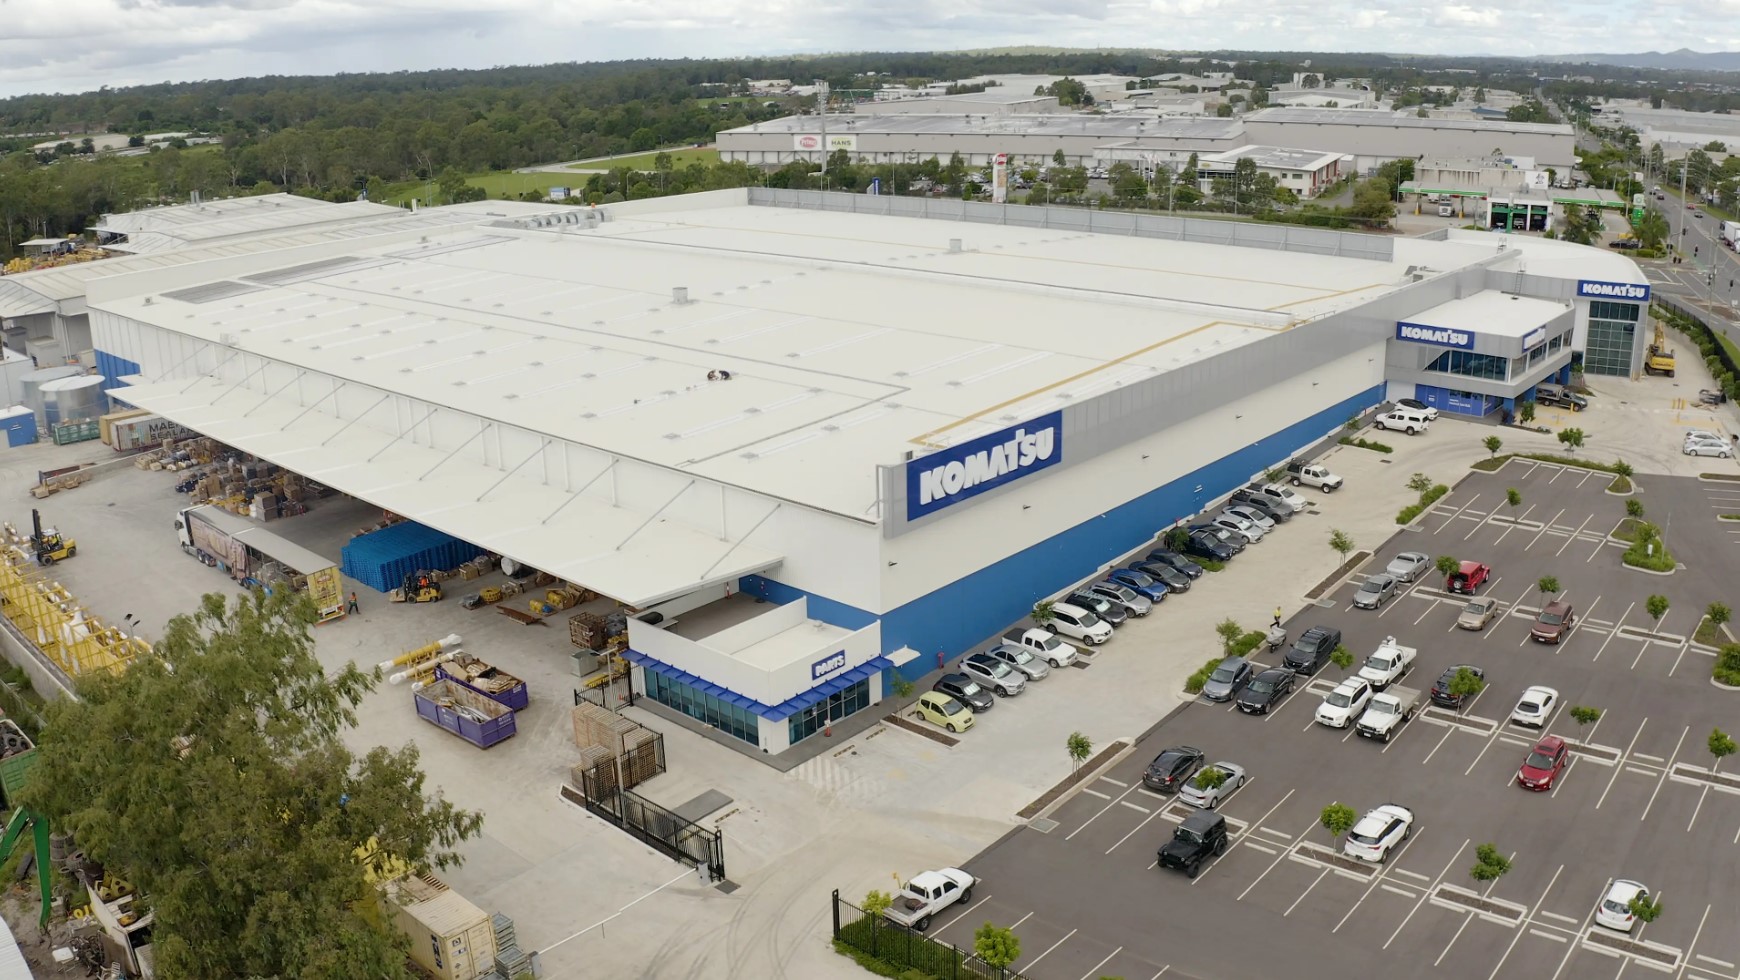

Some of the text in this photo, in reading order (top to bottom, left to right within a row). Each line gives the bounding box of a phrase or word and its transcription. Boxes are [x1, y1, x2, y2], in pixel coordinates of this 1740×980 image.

[1582, 283, 1645, 298] KOMATSU
[1401, 326, 1468, 345] KOMATSU
[149, 421, 179, 433] MAE
[920, 427, 1054, 505] KOMATSU
[815, 655, 844, 676] PARTS
